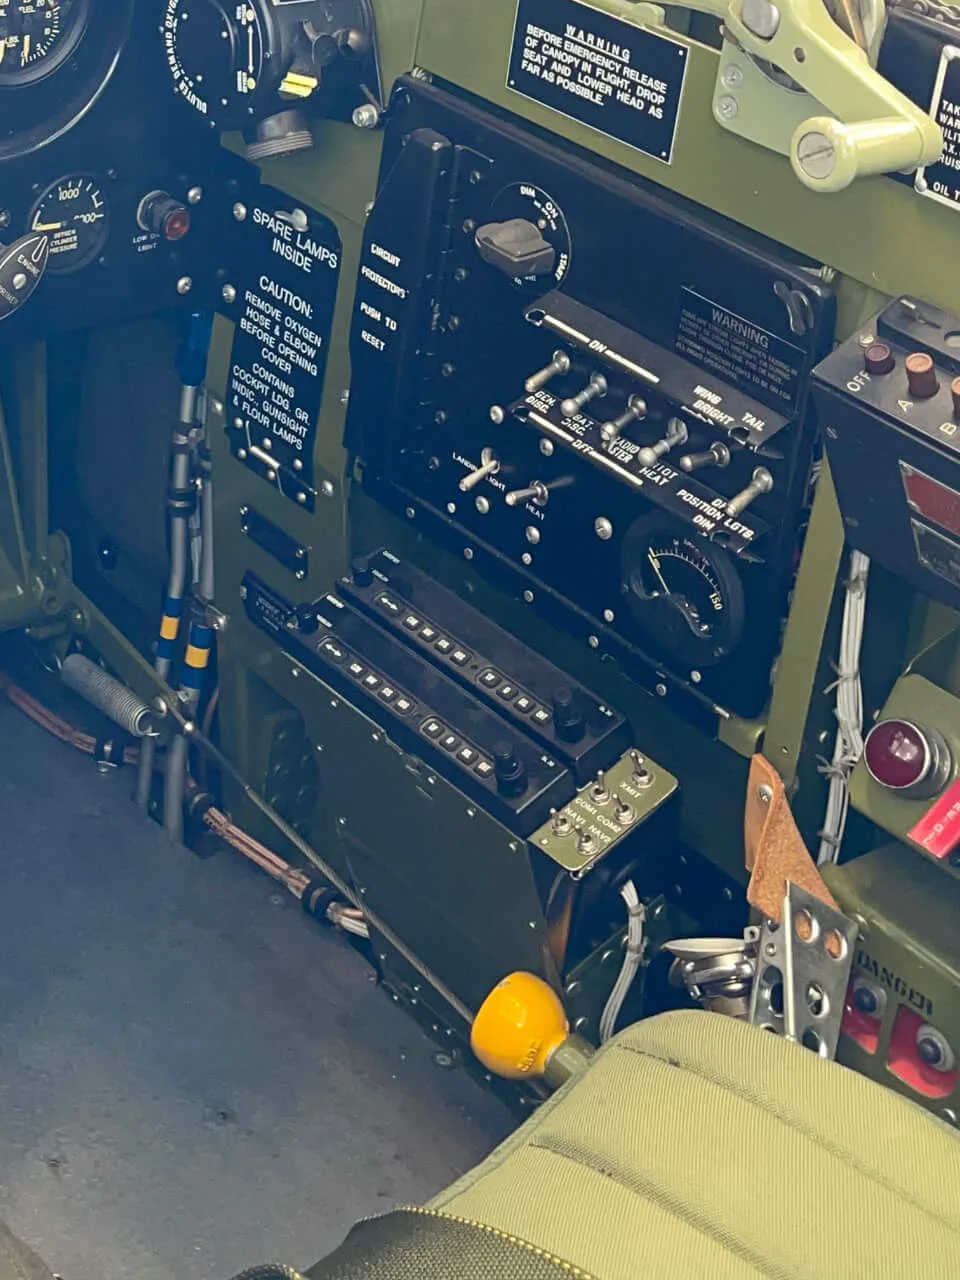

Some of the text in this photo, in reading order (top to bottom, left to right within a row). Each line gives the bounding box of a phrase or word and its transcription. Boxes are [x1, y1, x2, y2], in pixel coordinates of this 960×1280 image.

[527, 24, 668, 94] BEFORE EMERGENCY RELEASE
[566, 24, 631, 60] WARNING
[522, 60, 604, 106] FAR AS POSSIBLE.
[523, 49, 663, 120] SEAT AND LOWER HEAD AS
[525, 37, 539, 49] OF
[542, 45, 581, 67] CANOPY
[582, 62, 591, 73] IN
[636, 86, 665, 105] DROP
[253, 208, 338, 269] SPARE LAMPS
[272, 238, 313, 273] INSIDE
[371, 243, 400, 267] CIRCUIT
[362, 266, 406, 299] PROTECTORS
[555, 253, 568, 281] START
[260, 276, 313, 319] CAUTION:
[245, 291, 321, 347] REMOVE OXYGEN
[246, 307, 316, 358] HOSE & ELBOW
[361, 302, 397, 331] PUSH TO
[712, 309, 769, 349] WARNING
[240, 319, 318, 376] BEFORE OPENING
[362, 330, 386, 351] RESET
[262, 347, 292, 374] COVER
[233, 365, 310, 424] COCKPIT LDG. GR.
[253, 364, 295, 398] CONTAINS
[846, 370, 872, 393] OFF
[233, 395, 302, 450] & FLOUR LAMPS
[262, 401, 308, 438] GUNSIGHT
[692, 400, 734, 426] BRIGHT
[741, 412, 766, 432] TAIL
[676, 490, 754, 541] POSITION LGTS.
[564, 808, 586, 824] NAV1
[596, 815, 621, 834] COM2
[588, 826, 611, 843] NAV2
